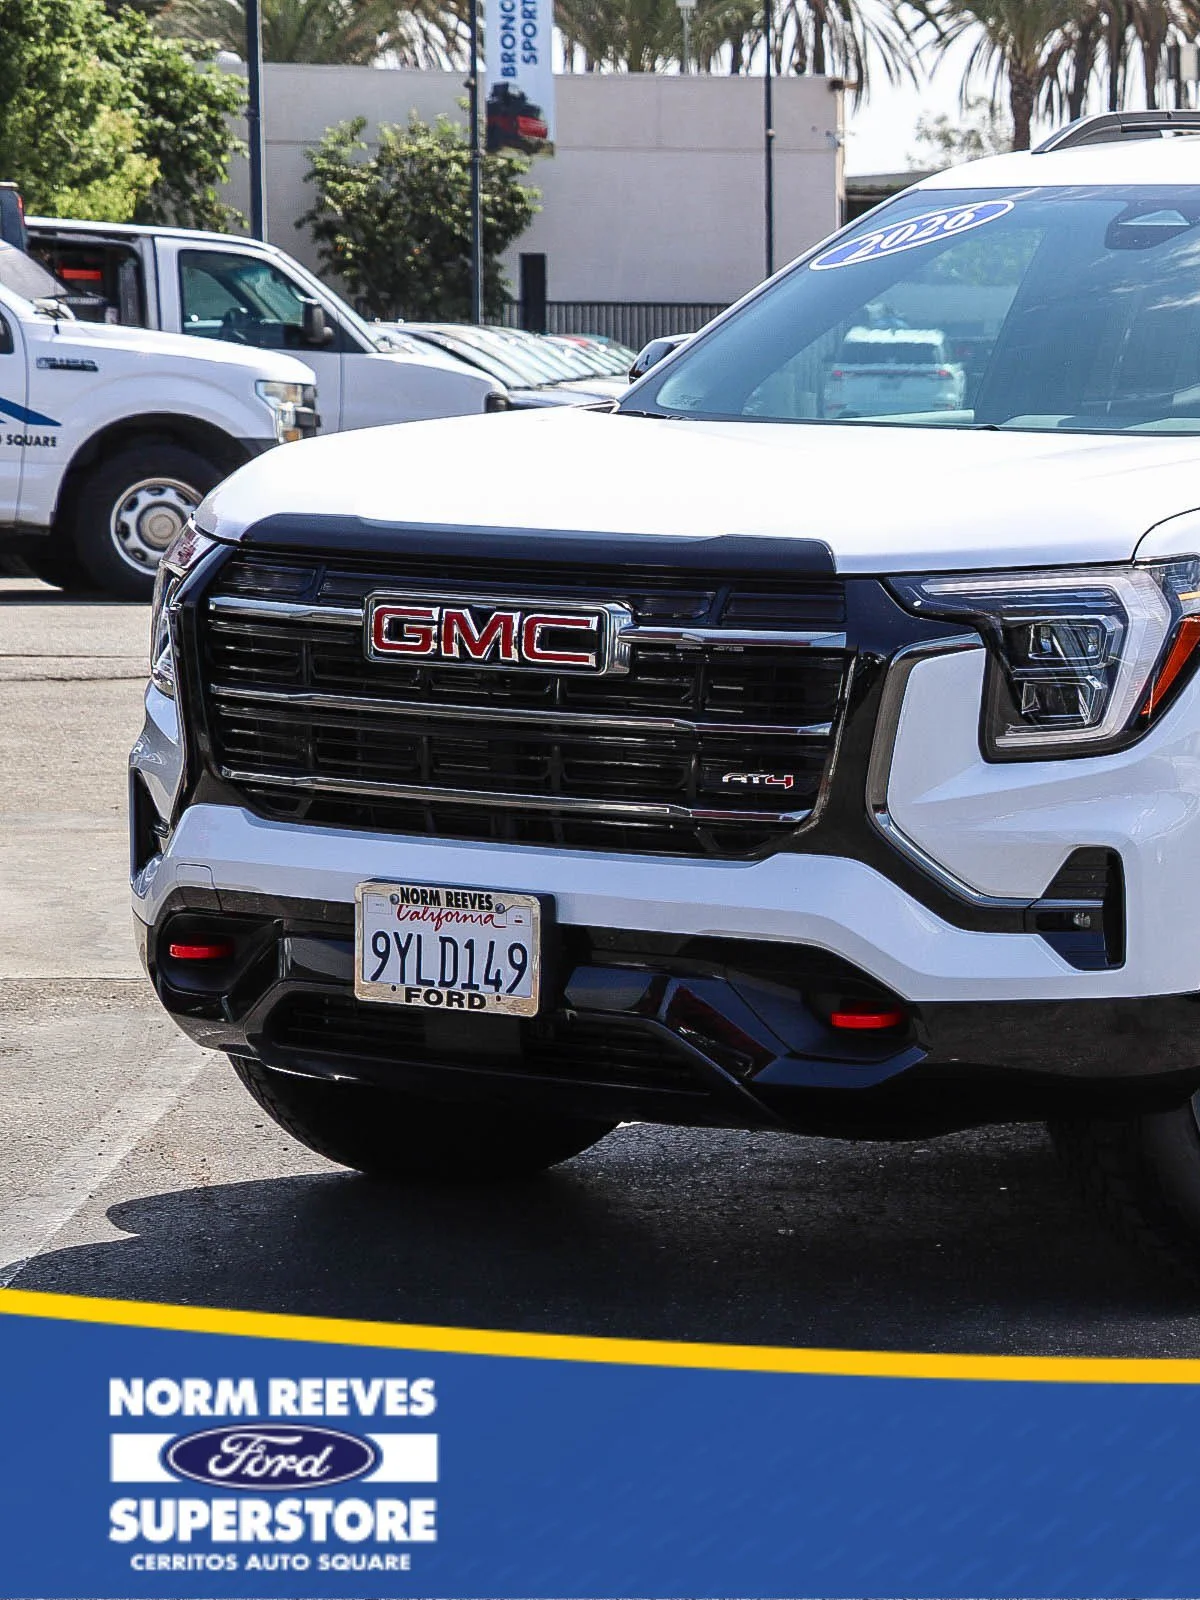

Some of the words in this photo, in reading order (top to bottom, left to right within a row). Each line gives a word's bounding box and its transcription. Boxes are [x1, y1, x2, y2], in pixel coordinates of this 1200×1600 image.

[522, 0, 537, 65] SPORT
[842, 205, 984, 262] 2026
[6, 434, 57, 447] SQUARE
[372, 604, 599, 667] GMC
[722, 772, 794, 789] AT4
[399, 887, 441, 907] NORM
[445, 892, 494, 912] REEVES
[397, 904, 507, 931] California
[370, 930, 528, 994] 9YLD149
[404, 986, 487, 1010] FORD
